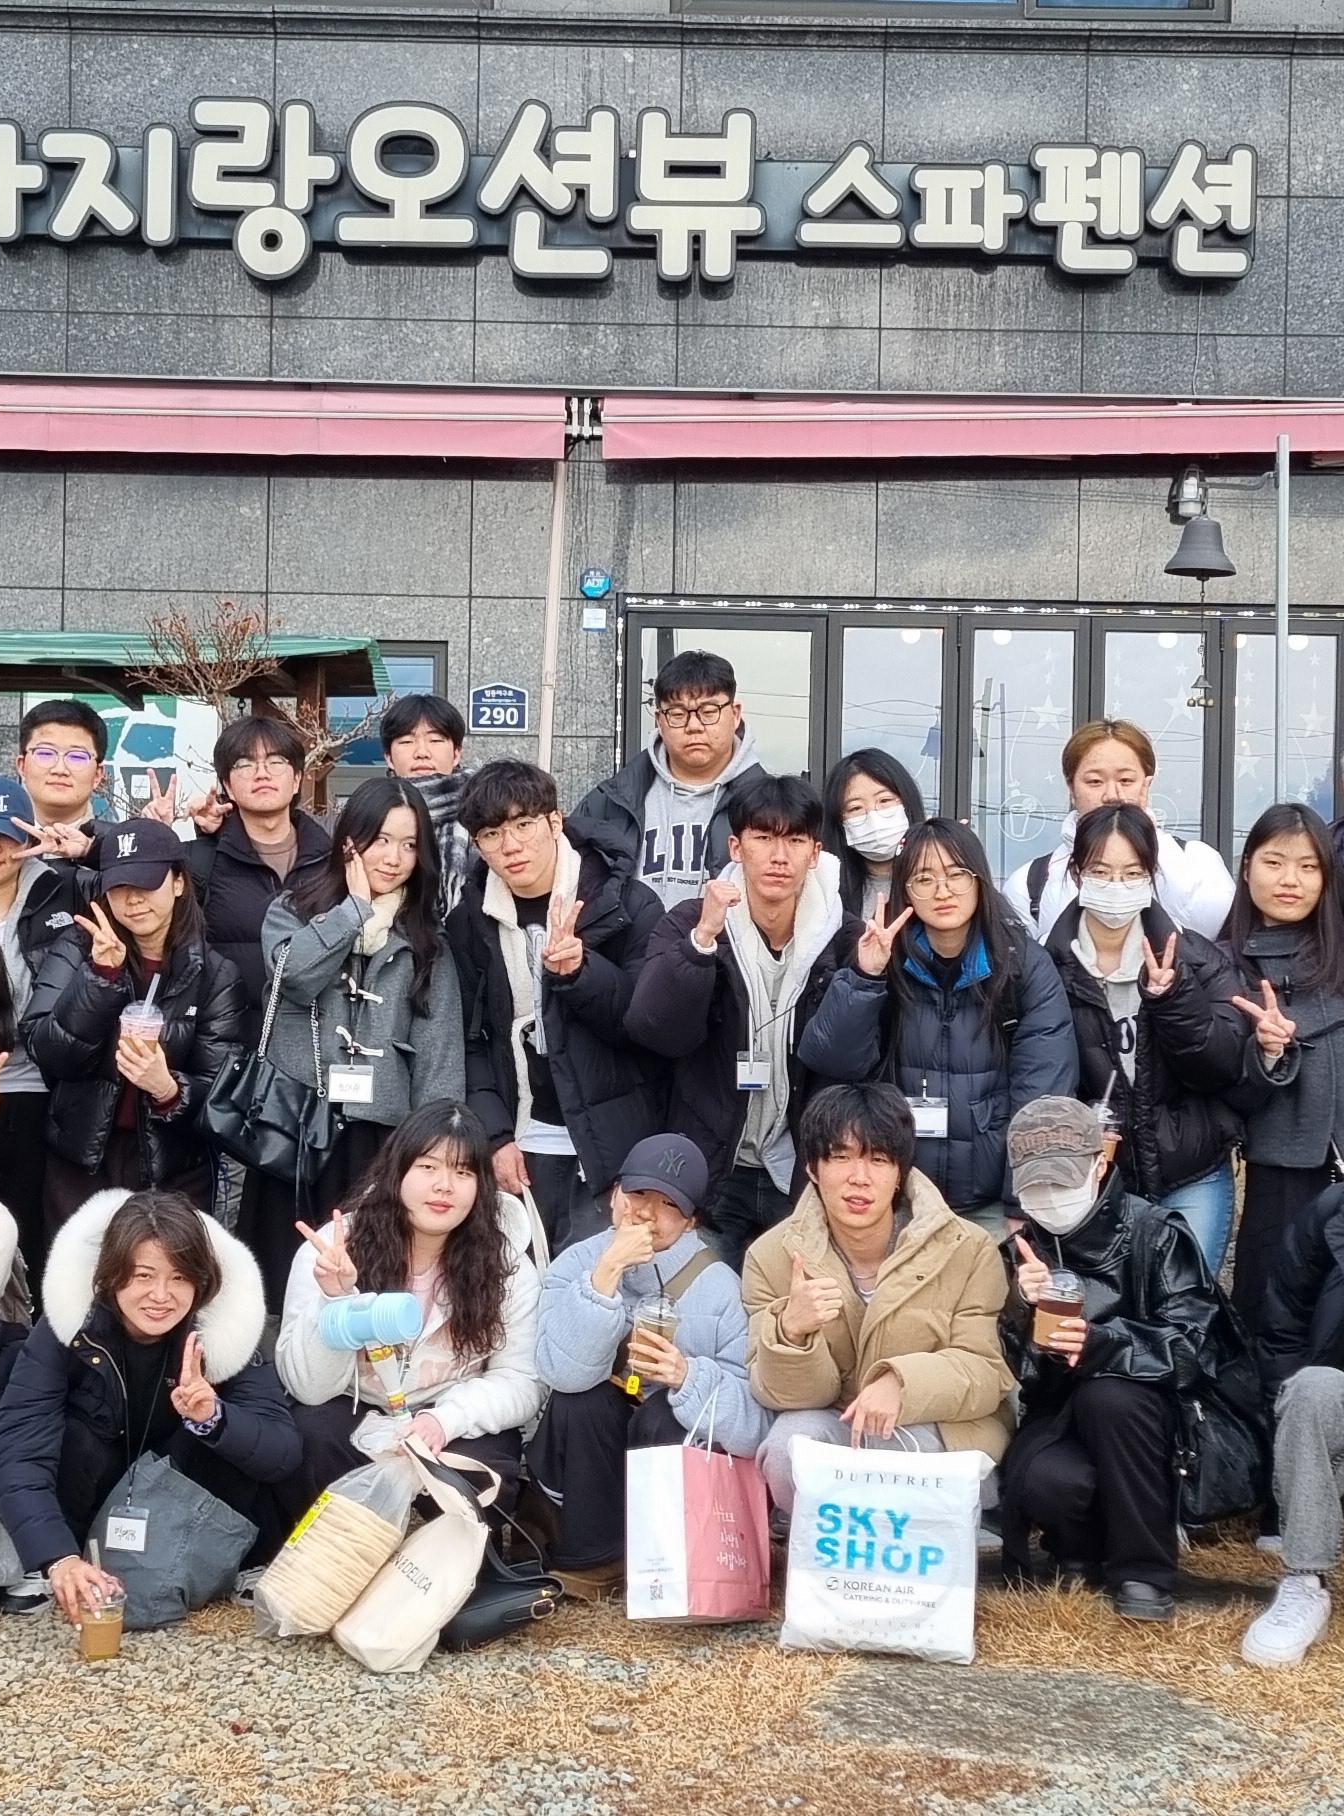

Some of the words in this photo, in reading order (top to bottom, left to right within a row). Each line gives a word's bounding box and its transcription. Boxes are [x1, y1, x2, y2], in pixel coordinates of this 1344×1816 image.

[796, 142, 1253, 279] 스파펜션
[478, 706, 519, 725] 290
[816, 1503, 911, 1540] SKY
[814, 1536, 945, 1576] SHOP
[843, 1580, 892, 1593] KOREAN
[895, 1585, 915, 1596] AIR
[843, 1593, 883, 1604] CATERING
